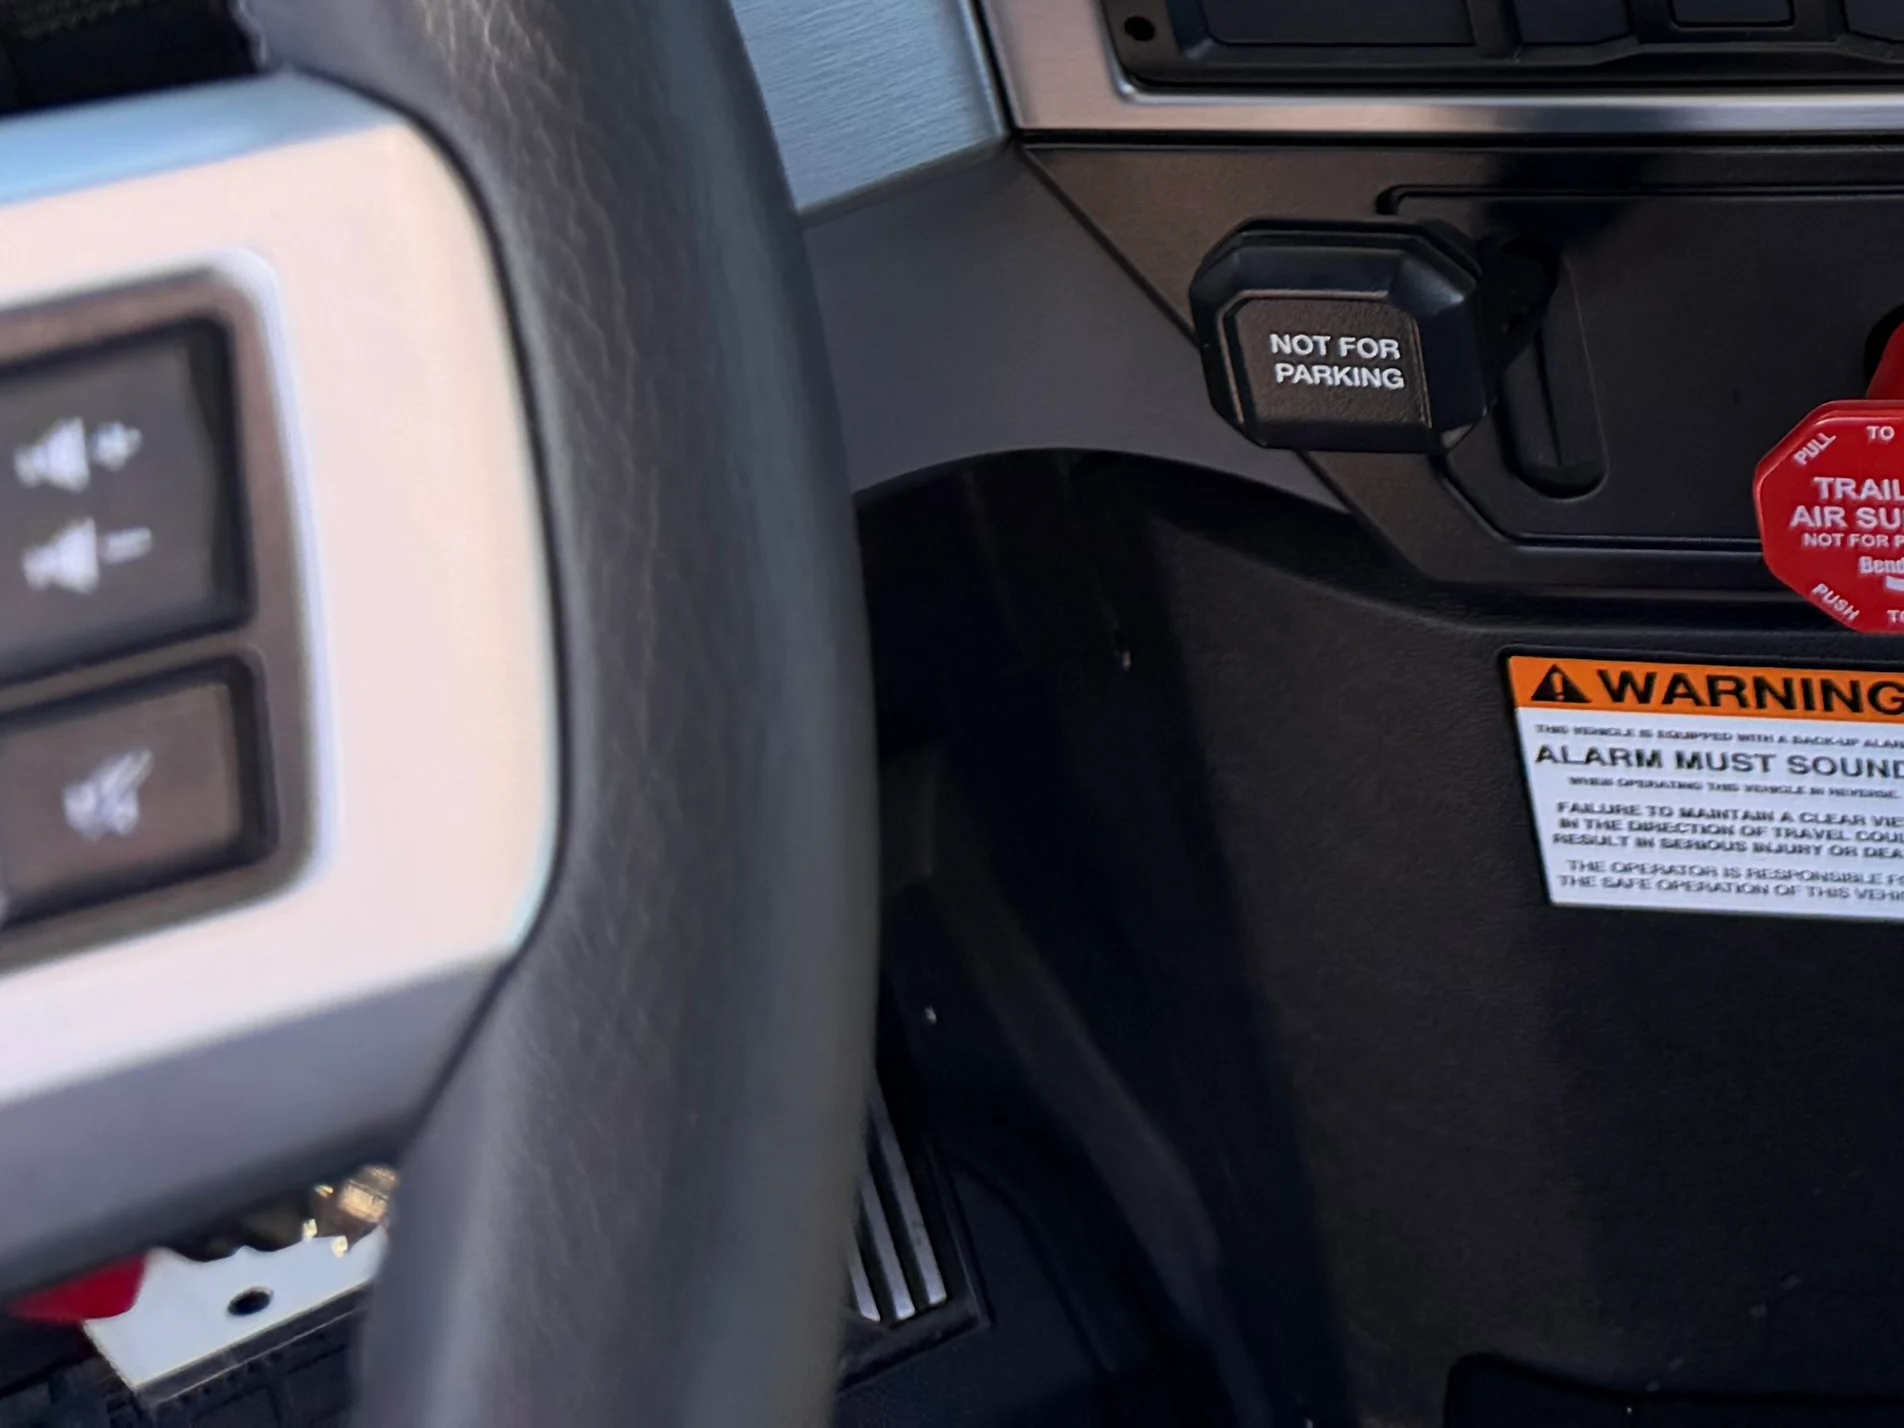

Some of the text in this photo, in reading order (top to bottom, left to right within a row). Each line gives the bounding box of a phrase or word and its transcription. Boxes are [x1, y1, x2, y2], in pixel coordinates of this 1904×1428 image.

[1269, 334, 1400, 360] NOT FOR
[1275, 363, 1405, 390] PARKING
[1793, 432, 1836, 466] PULL
[1867, 426, 1896, 441] TO
[1790, 505, 1848, 528] AIR
[1803, 532, 1844, 547] NOT
[1850, 534, 1889, 548] FOR
[1811, 583, 1860, 621] PUSH
[1535, 744, 1663, 768] ALARM
[1675, 750, 1776, 773] MUST
[1557, 802, 1643, 815] FAILURE
[1646, 805, 1674, 817] TO
[1679, 807, 1774, 822] MAINTAIN
[1781, 811, 1794, 822] A
[1799, 812, 1866, 825] CLEAR
[1559, 818, 1579, 829] IN
[1583, 819, 1624, 831] THE
[1628, 820, 1735, 835] DIRECTION
[1741, 826, 1768, 836] OF
[1773, 827, 1850, 841] TRAVEL
[1552, 834, 1630, 846] RESULT
[1634, 838, 1654, 848] IN
[1660, 838, 1747, 851] SERIOUS
[1752, 842, 1823, 855] INJURY
[1828, 845, 1858, 856] OR
[1566, 860, 1606, 872] THE
[1610, 861, 1717, 877] OPERATOR
[1723, 866, 1741, 878] IS
[1747, 868, 1883, 884] RESPONSIBLE
[1557, 875, 1597, 888] THE
[1601, 876, 1651, 890] SAFE
[1657, 879, 1769, 896] OPERATION
[1774, 884, 1800, 896] OF
[1806, 886, 1850, 899] THIS
